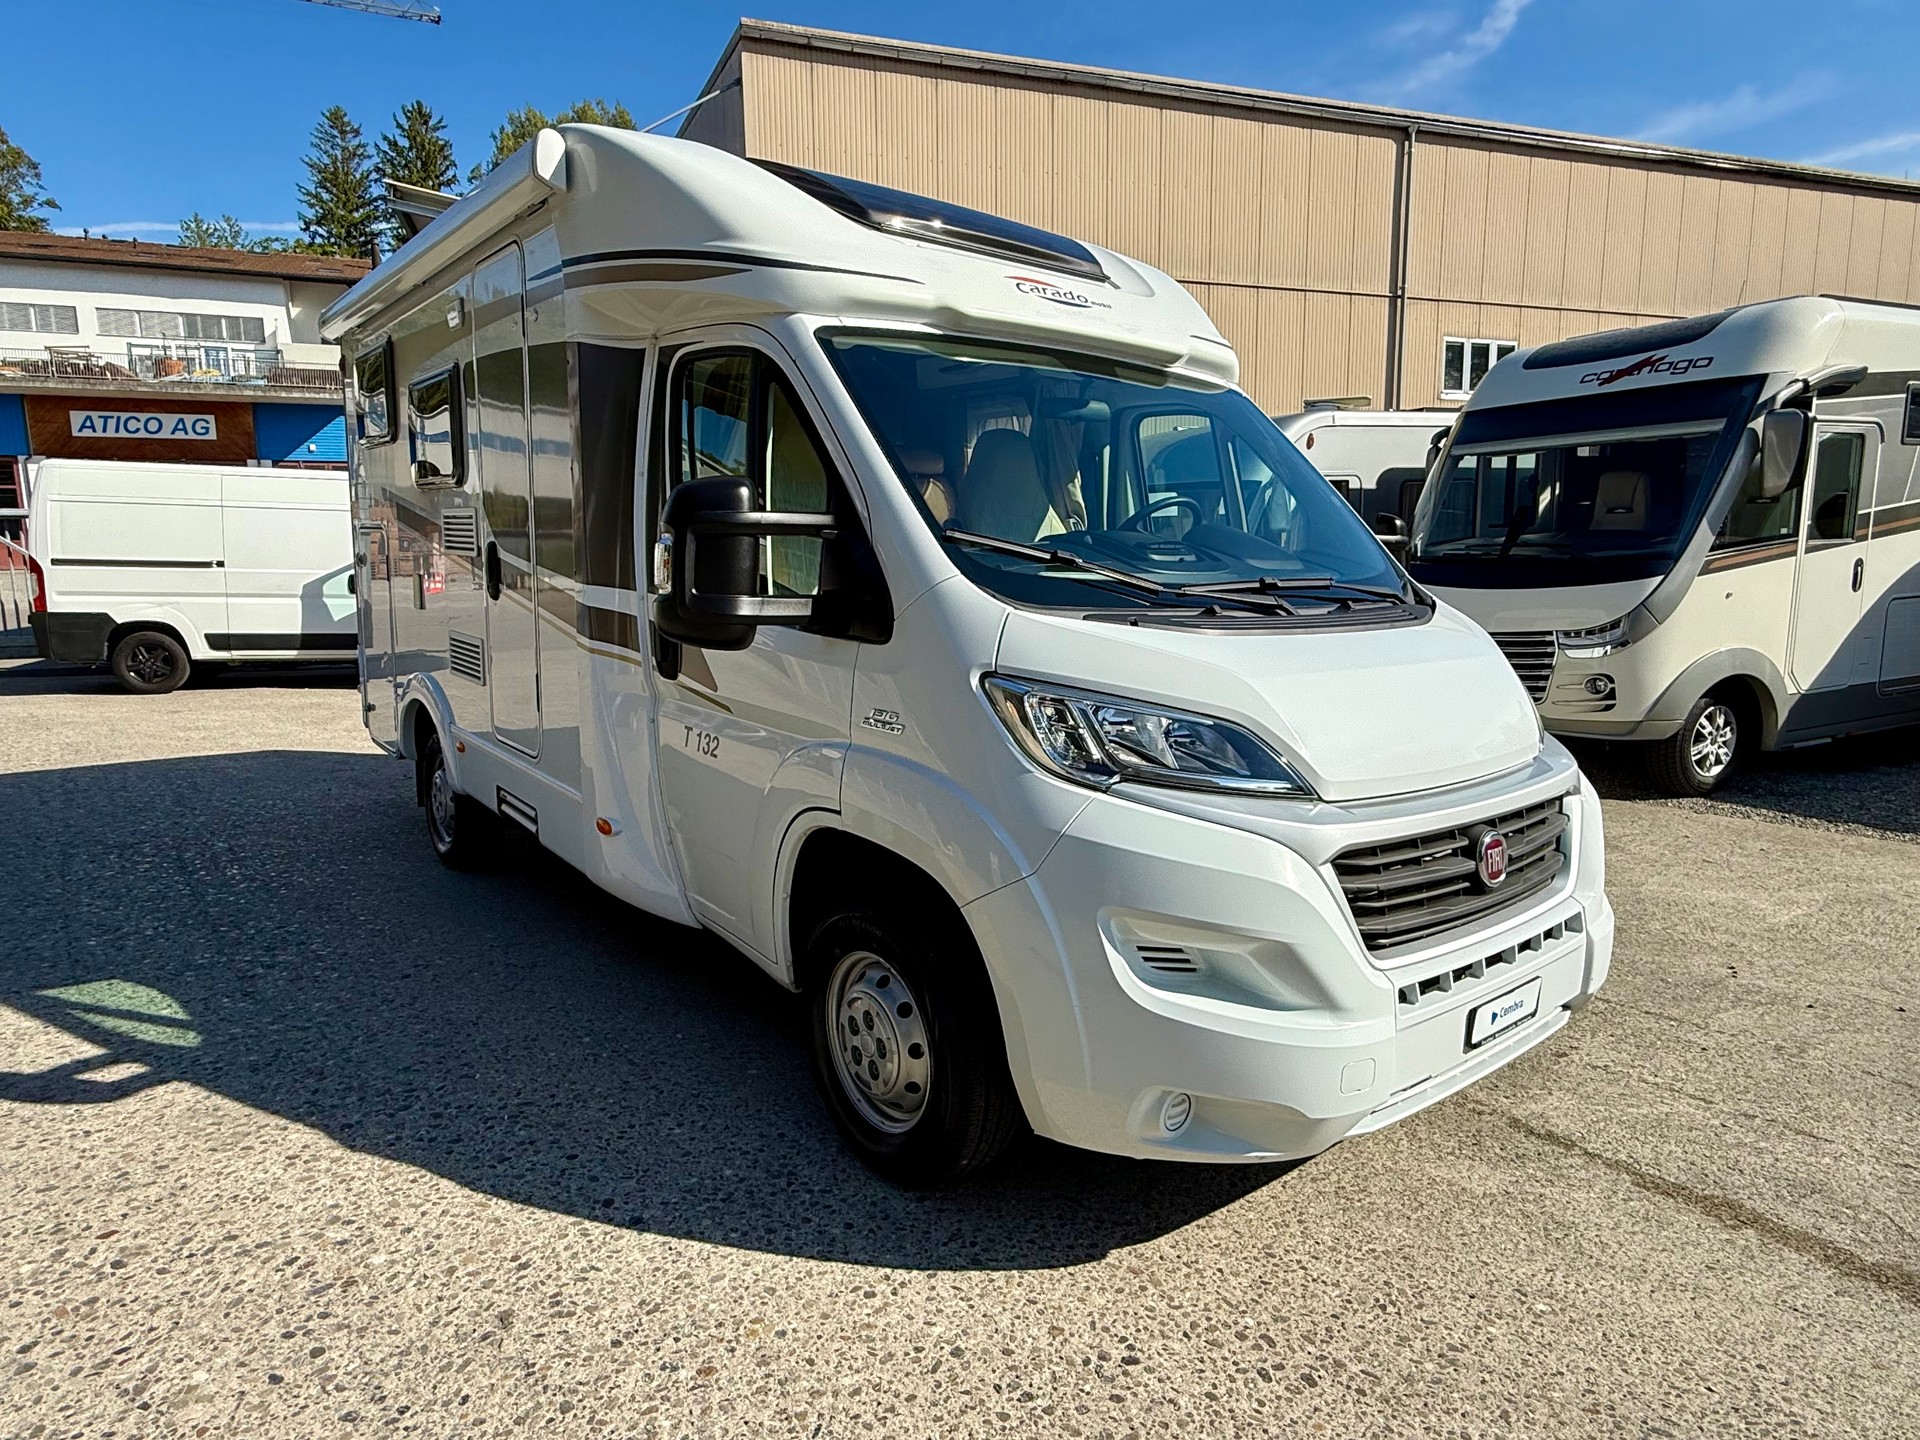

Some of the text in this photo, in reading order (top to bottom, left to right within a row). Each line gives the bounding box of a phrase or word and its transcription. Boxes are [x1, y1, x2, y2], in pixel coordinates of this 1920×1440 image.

[1578, 355, 1715, 385] cahago
[77, 414, 211, 436] ATICO AG
[684, 726, 720, 759] T 132
[1486, 846, 1504, 873] FIAT
